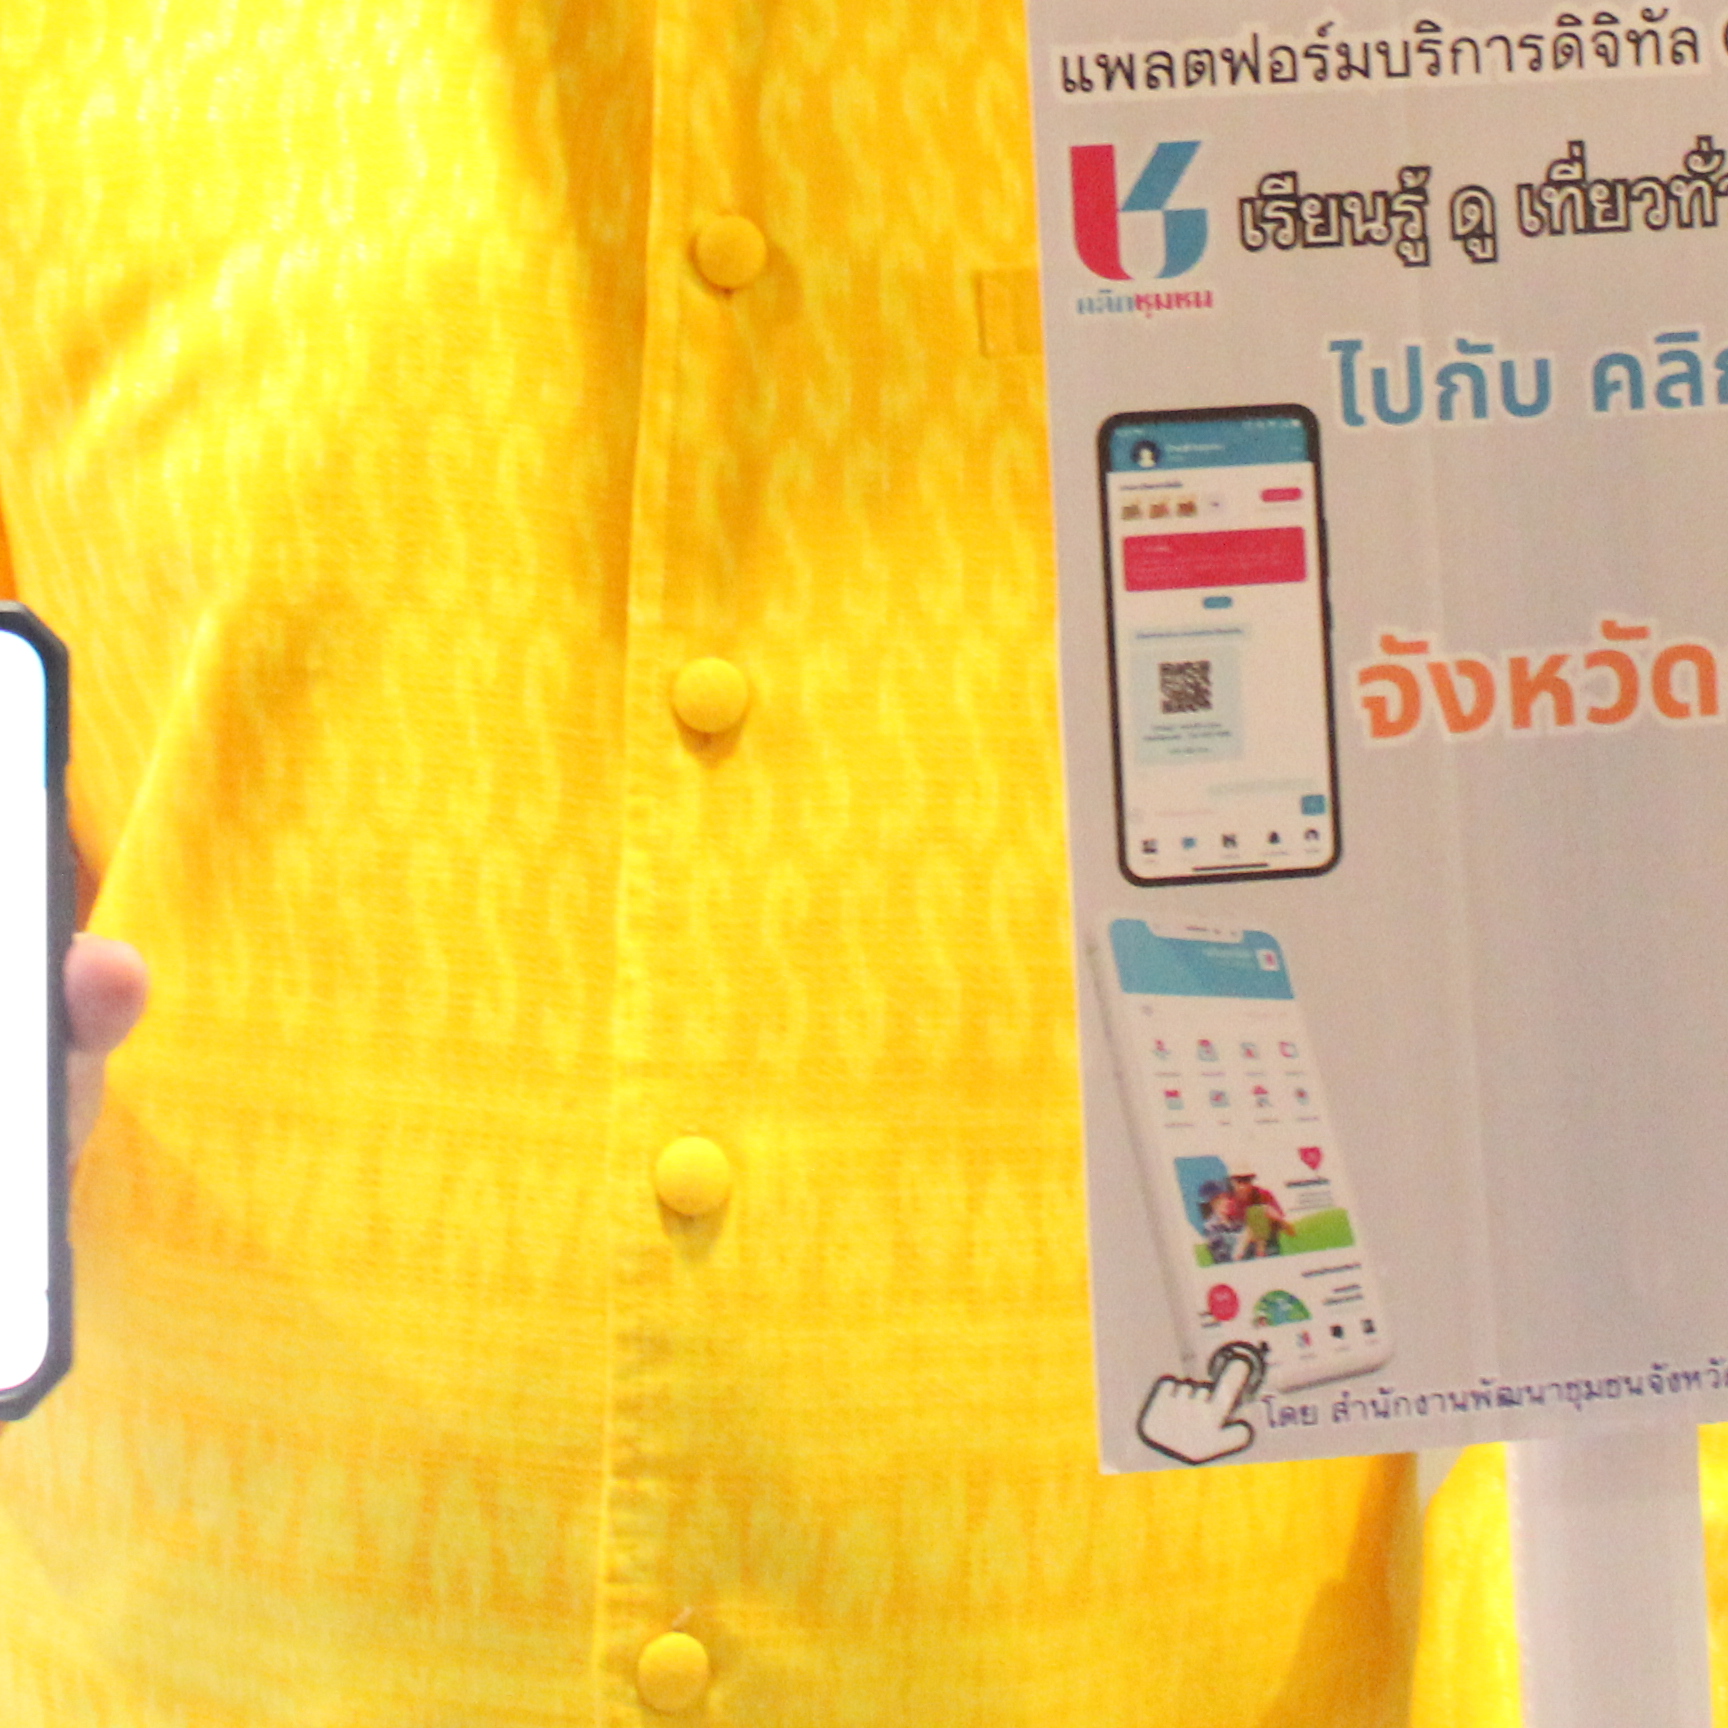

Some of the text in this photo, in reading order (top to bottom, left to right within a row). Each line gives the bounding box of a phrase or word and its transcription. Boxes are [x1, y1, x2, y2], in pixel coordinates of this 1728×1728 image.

[1060, 7, 1701, 93] แพลตฟอร์มบริการดิจิทัล
[1238, 165, 1431, 267] เรียนรู้
[1450, 185, 1498, 263] ดู
[1329, 337, 1552, 427] ไปกับ
[1261, 1394, 1319, 1429] โดย
